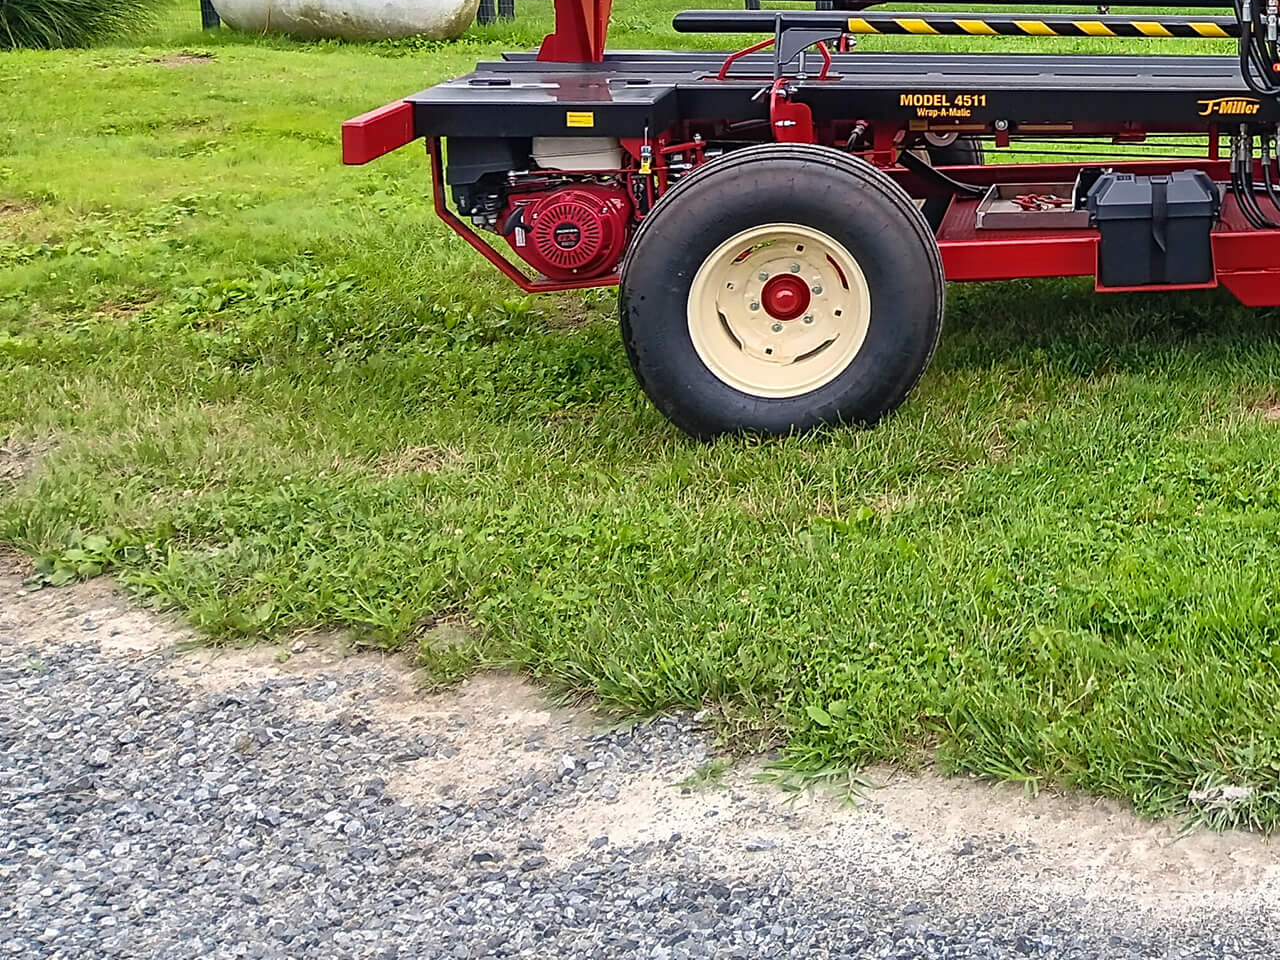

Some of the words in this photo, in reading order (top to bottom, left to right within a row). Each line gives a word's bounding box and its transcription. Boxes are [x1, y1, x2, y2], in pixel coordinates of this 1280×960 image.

[900, 94, 950, 106] MODEL
[954, 94, 986, 106] 4511
[1197, 97, 1260, 115] J-Miller
[916, 107, 971, 117] Wrap-A-Matic
